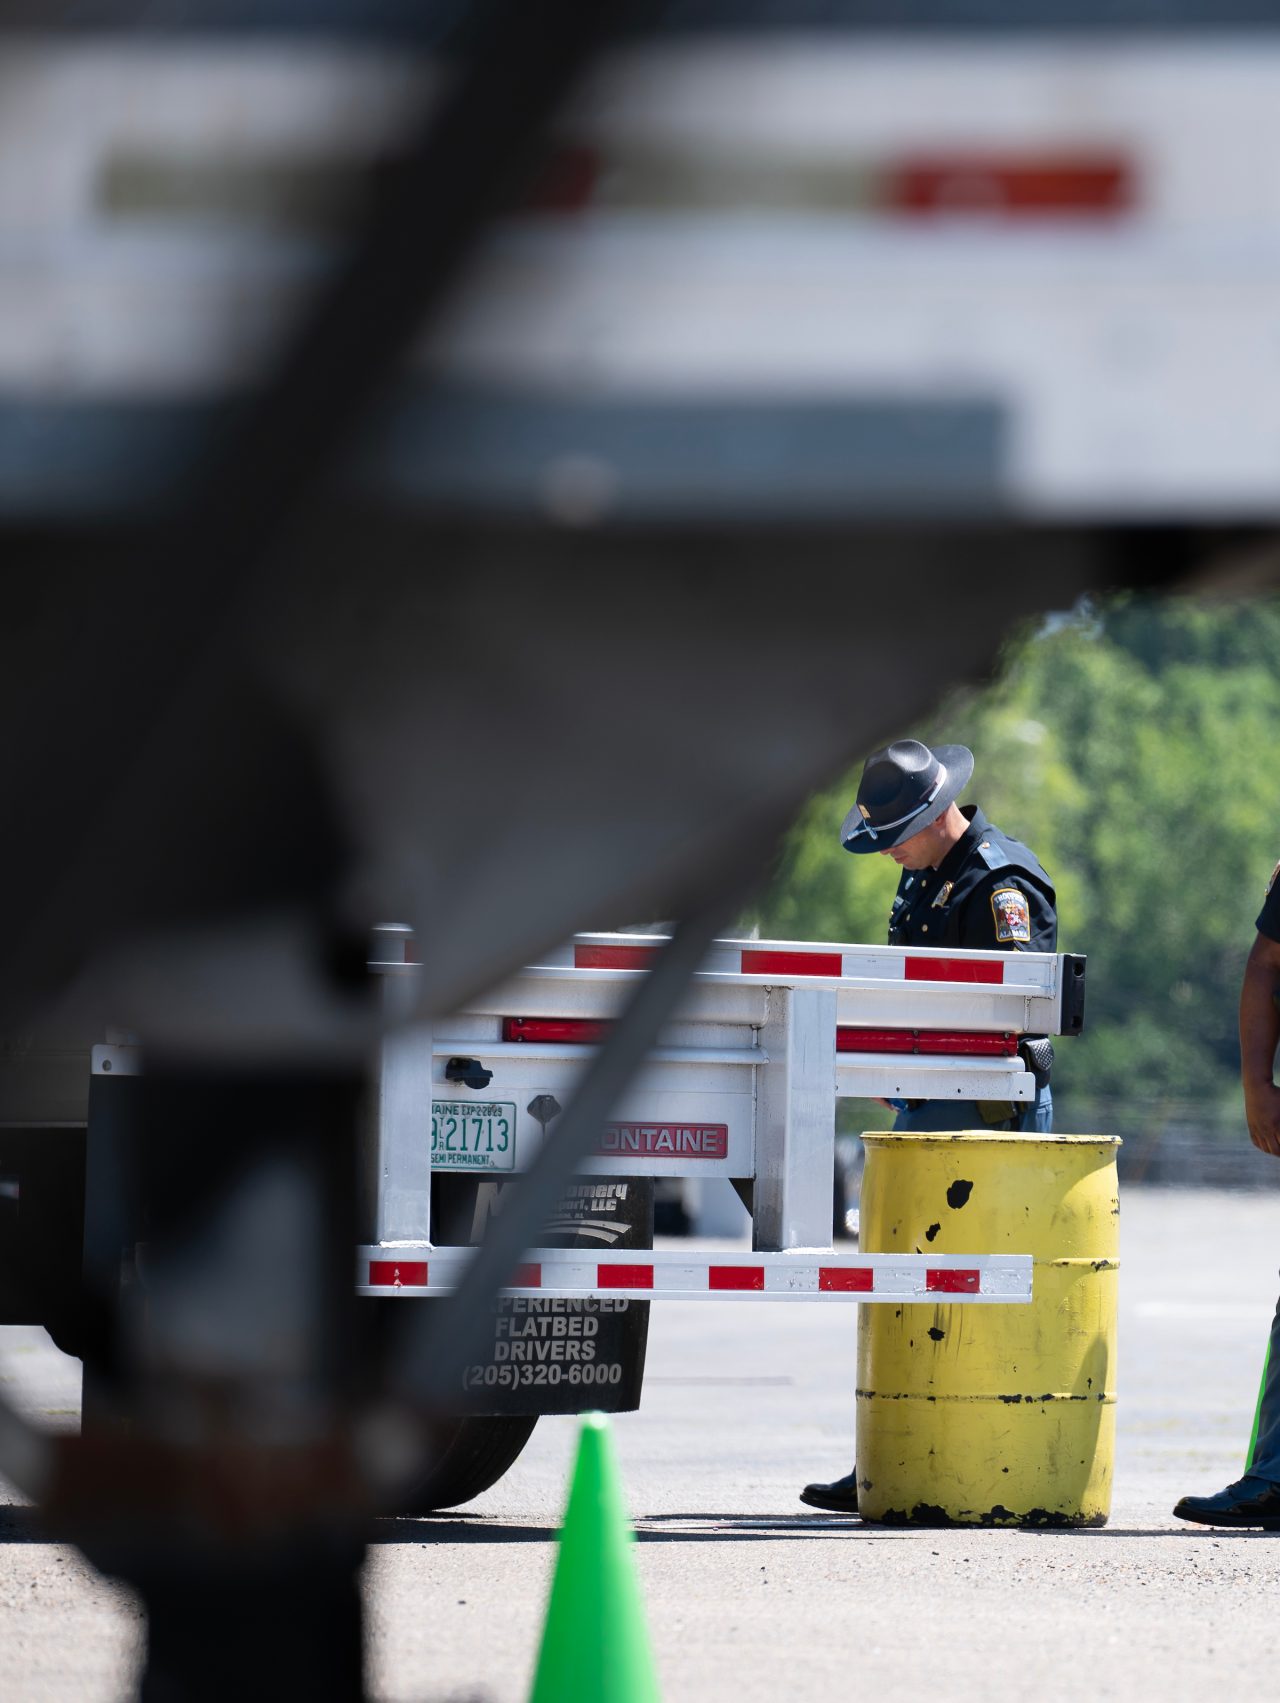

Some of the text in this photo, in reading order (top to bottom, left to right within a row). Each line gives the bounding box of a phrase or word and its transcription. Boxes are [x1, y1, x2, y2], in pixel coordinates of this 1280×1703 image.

[432, 1105, 459, 1115] AINE
[600, 1128, 718, 1152] ONTAINE
[431, 1153, 490, 1166] SEMI PERMANENT
[591, 1198, 618, 1212] LLC
[496, 1298, 629, 1313] PERIENCED
[495, 1316, 599, 1337] FLATBED
[494, 1340, 596, 1361] DRIVERS
[462, 1363, 622, 1391] (205)320-6000
